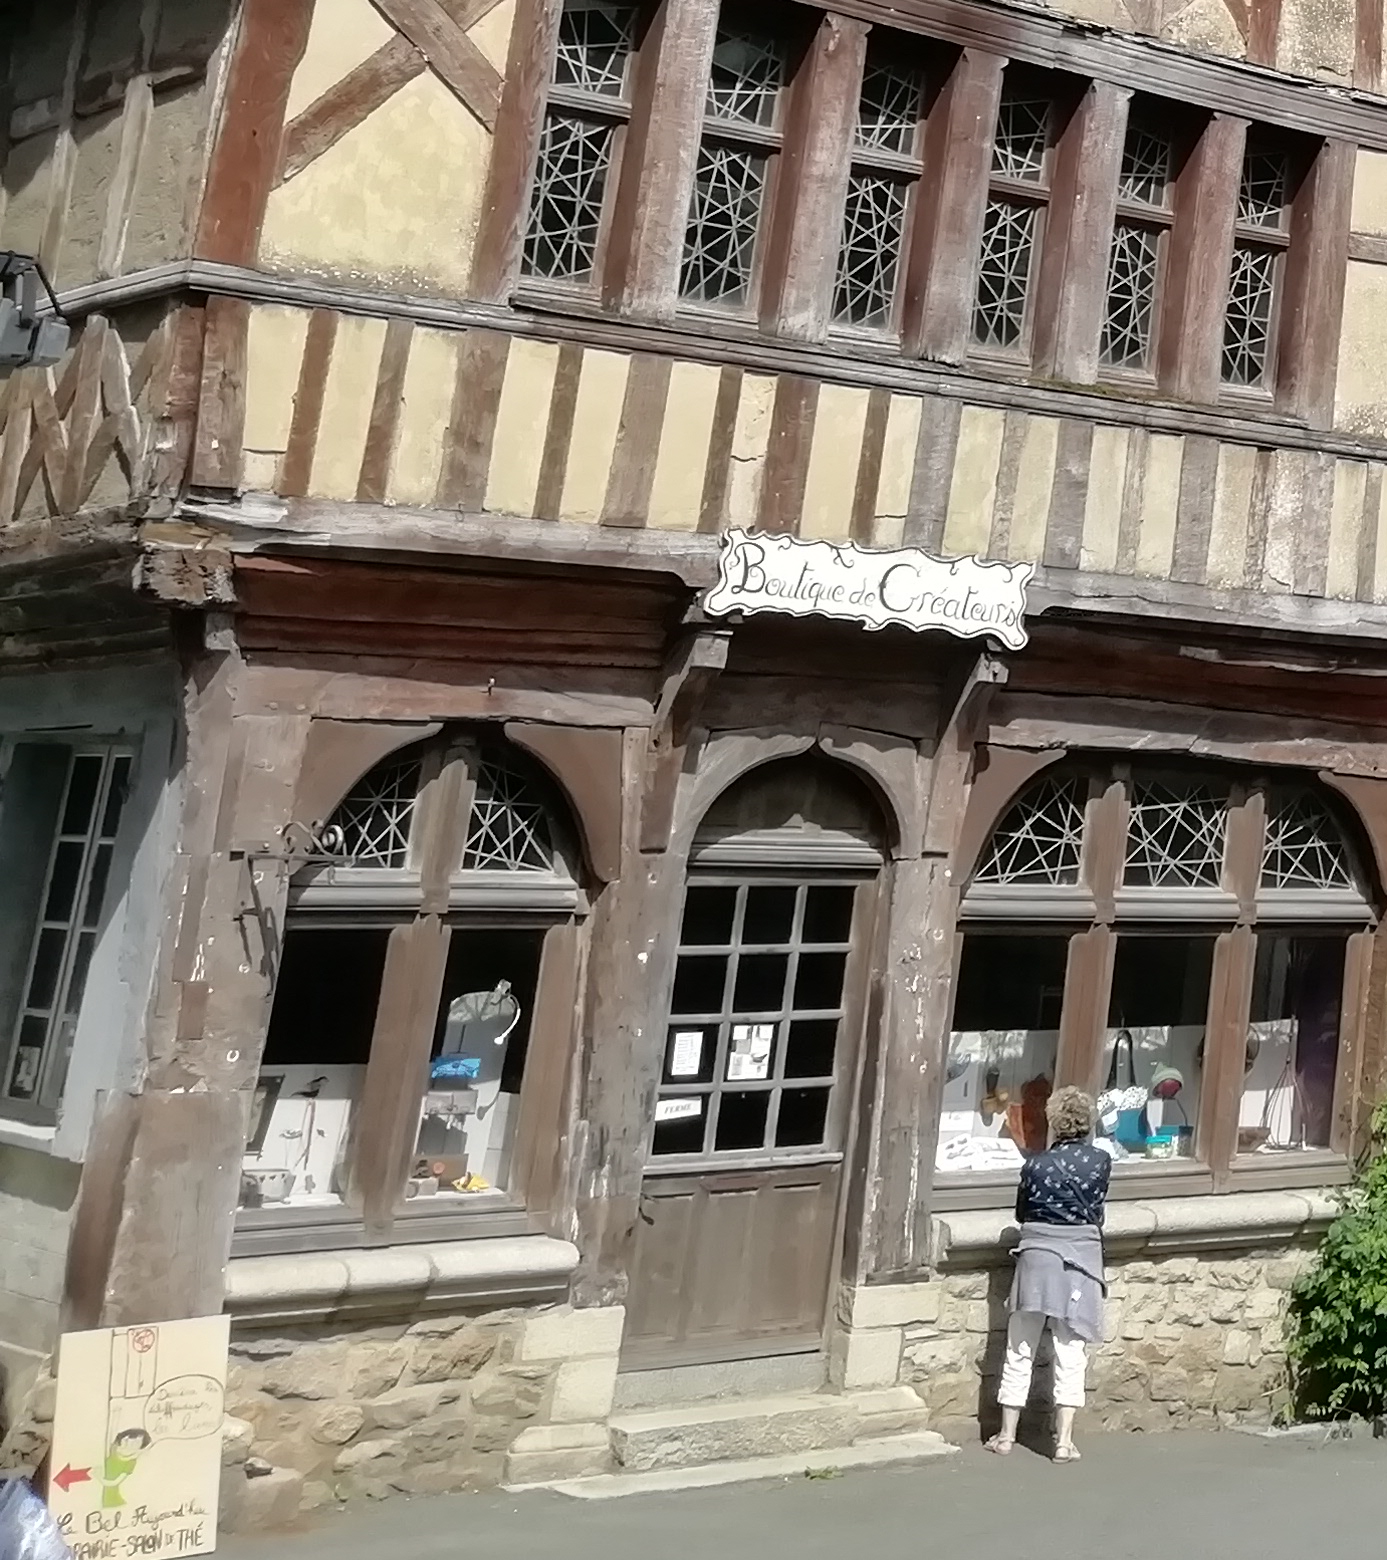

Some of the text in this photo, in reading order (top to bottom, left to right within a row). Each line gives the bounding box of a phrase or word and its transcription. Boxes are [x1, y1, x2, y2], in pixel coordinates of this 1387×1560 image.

[730, 542, 1018, 627] Boutique de Créateurs
[176, 1520, 205, 1552] THÉ
